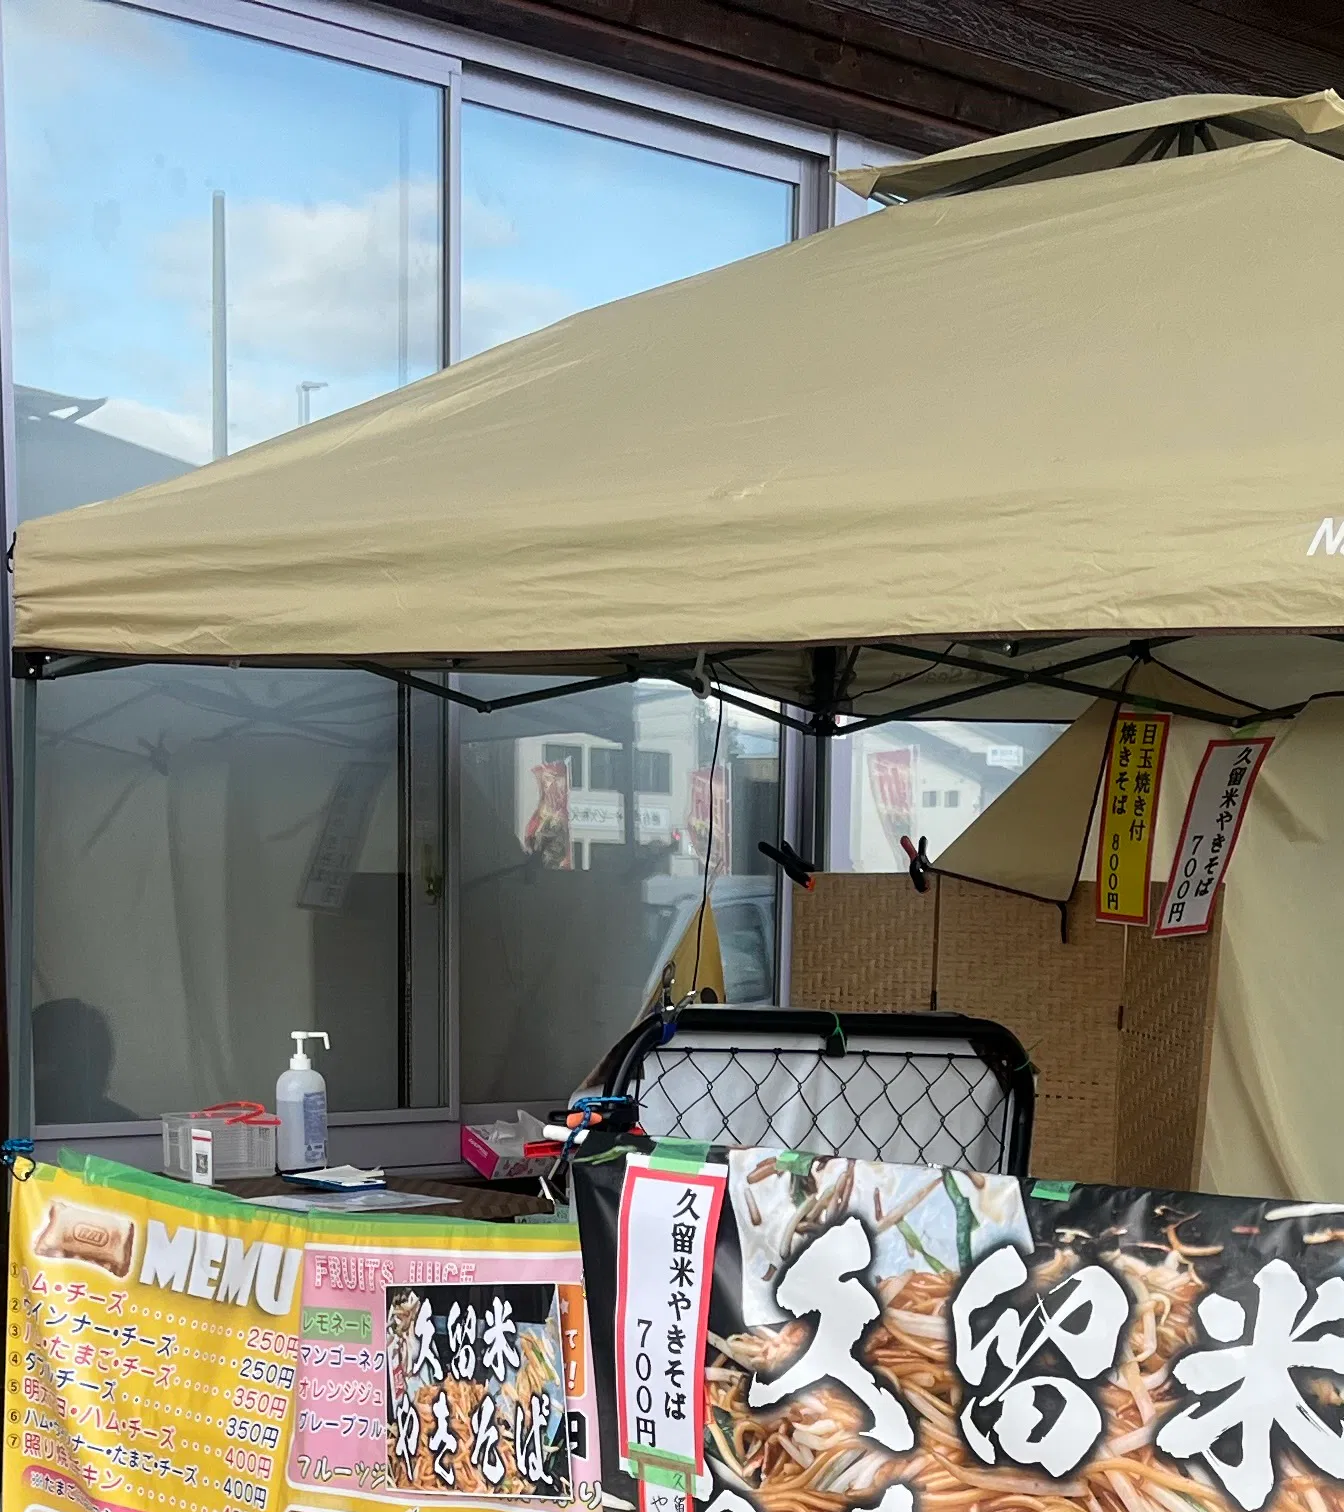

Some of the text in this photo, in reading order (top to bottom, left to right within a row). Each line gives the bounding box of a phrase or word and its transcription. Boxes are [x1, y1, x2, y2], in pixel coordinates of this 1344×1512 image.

[1107, 722, 1137, 911] 焼きそば 800円
[1130, 723, 1157, 842] 目玉焼き付
[1194, 747, 1253, 898] 久留米やきそば
[1168, 835, 1203, 924] 700円
[139, 1219, 303, 1316] MEMU
[314, 1255, 395, 1290] FRUITS
[664, 1188, 700, 1421] 久留米やきそば
[246, 1328, 301, 1360] 250円
[302, 1308, 372, 1338] レモネード
[413, 1296, 519, 1382] 久留米
[232, 1388, 287, 1421] 350円
[239, 1359, 296, 1390] 250円
[636, 1318, 656, 1448] 700円
[225, 1417, 280, 1449] 350円
[225, 1448, 273, 1480] 400円
[396, 1391, 553, 1485] やきそば
[223, 1477, 268, 1510] 400円
